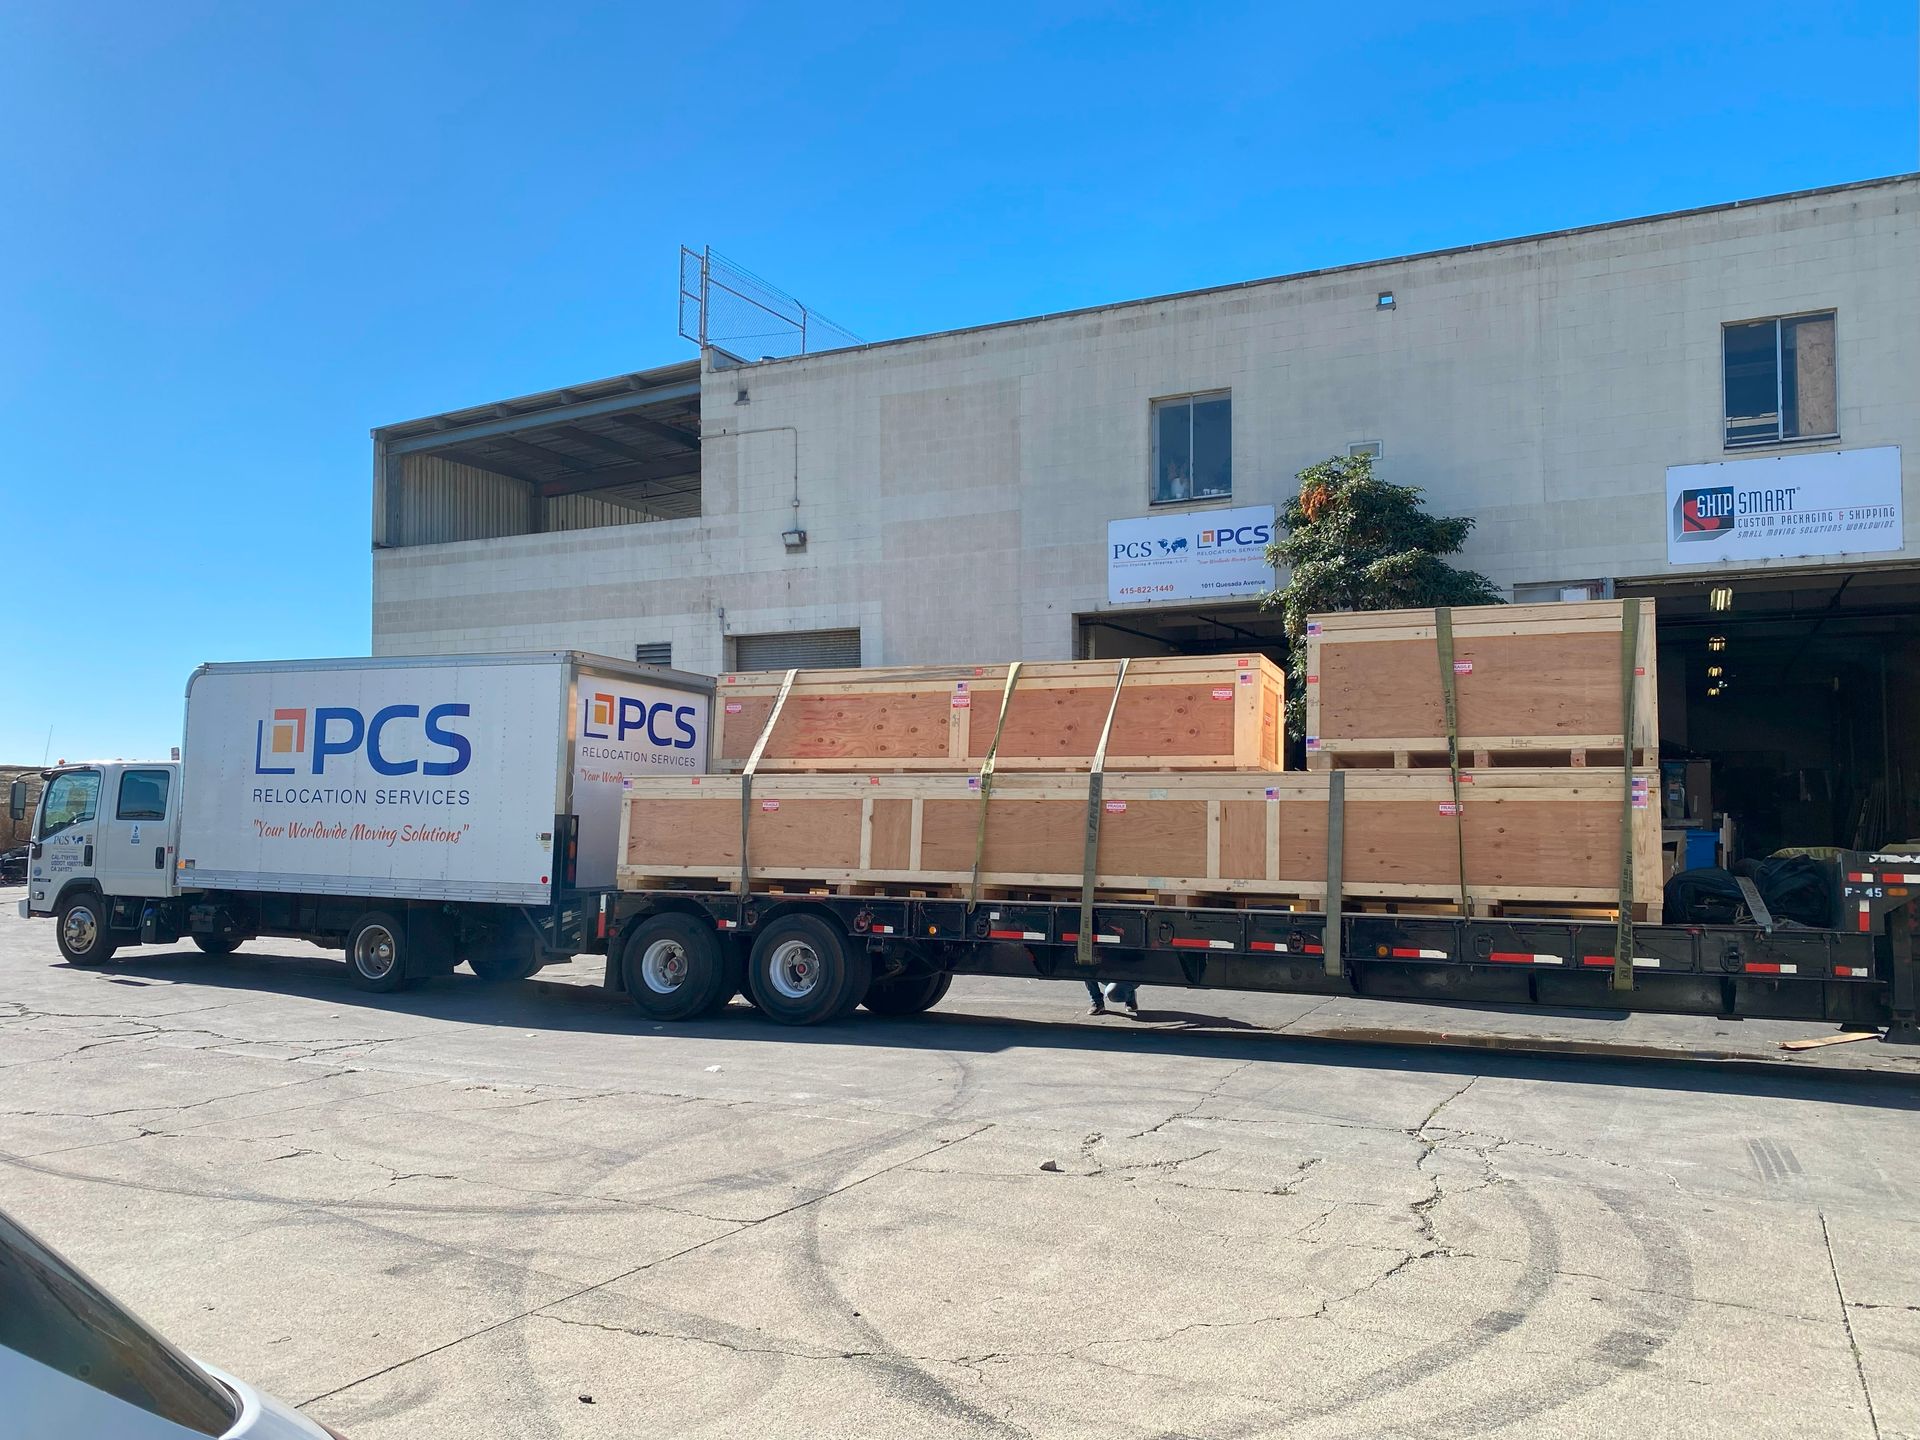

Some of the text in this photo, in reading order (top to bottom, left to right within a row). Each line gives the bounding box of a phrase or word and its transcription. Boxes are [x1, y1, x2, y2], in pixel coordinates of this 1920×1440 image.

[1697, 493, 1732, 518] SHIP
[1738, 507, 1895, 528] CUSTOM PACKAGING & SHIPPING
[1217, 525, 1270, 547] PCS
[1737, 520, 1895, 539] SMALL MOVING SOLUTIONS WORLDWIDE
[1113, 541, 1152, 559] PCS
[1119, 584, 1174, 595] 415-822-1449
[618, 697, 696, 749] PCS
[312, 703, 472, 776] PCS
[582, 747, 696, 768] RELOCATION SERVICES
[252, 788, 470, 805] RELOCATION SERVICES
[53, 835, 70, 845] PCS
[288, 821, 347, 841] Worldwide
[350, 823, 398, 847] Moving
